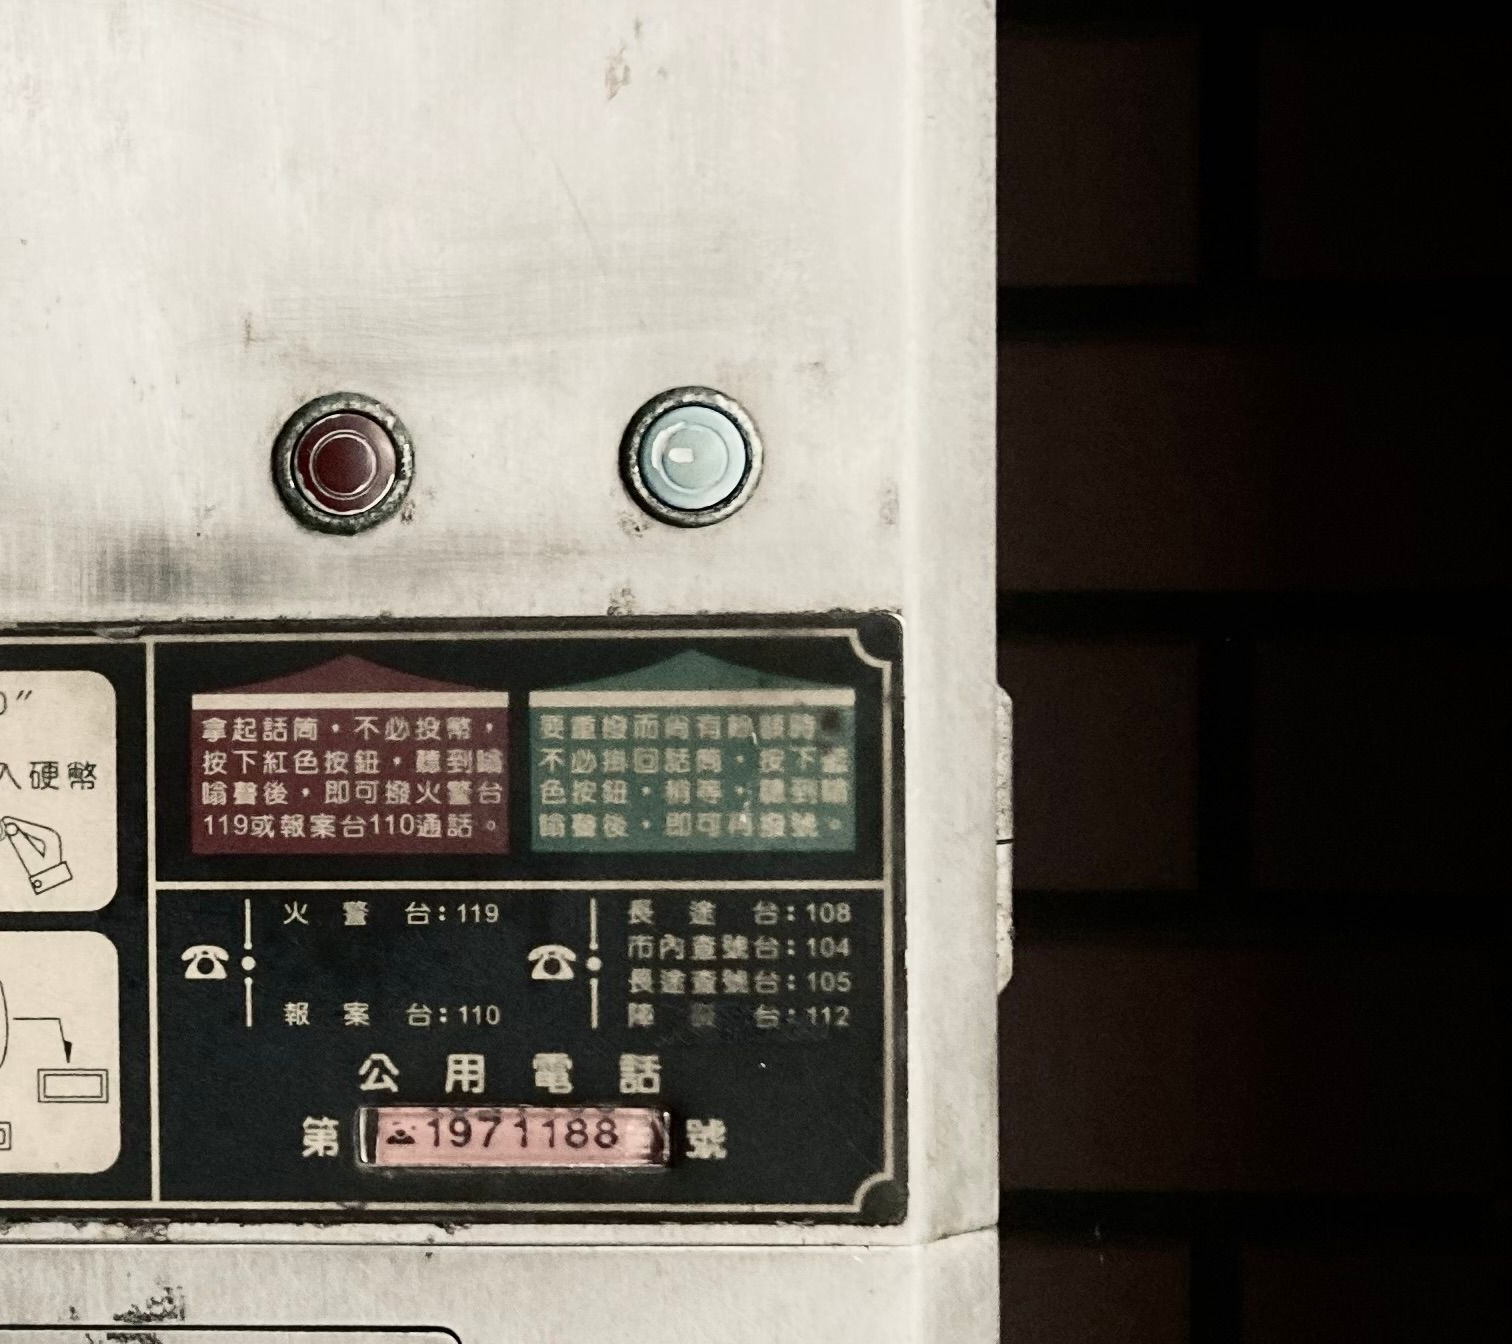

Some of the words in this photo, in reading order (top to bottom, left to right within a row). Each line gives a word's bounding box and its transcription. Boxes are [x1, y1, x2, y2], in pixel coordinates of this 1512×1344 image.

[358, 1052, 662, 1094] 公用電話
[302, 1116, 339, 1157] 第
[428, 1115, 619, 1150] 1971188
[686, 1118, 727, 1160] 號
